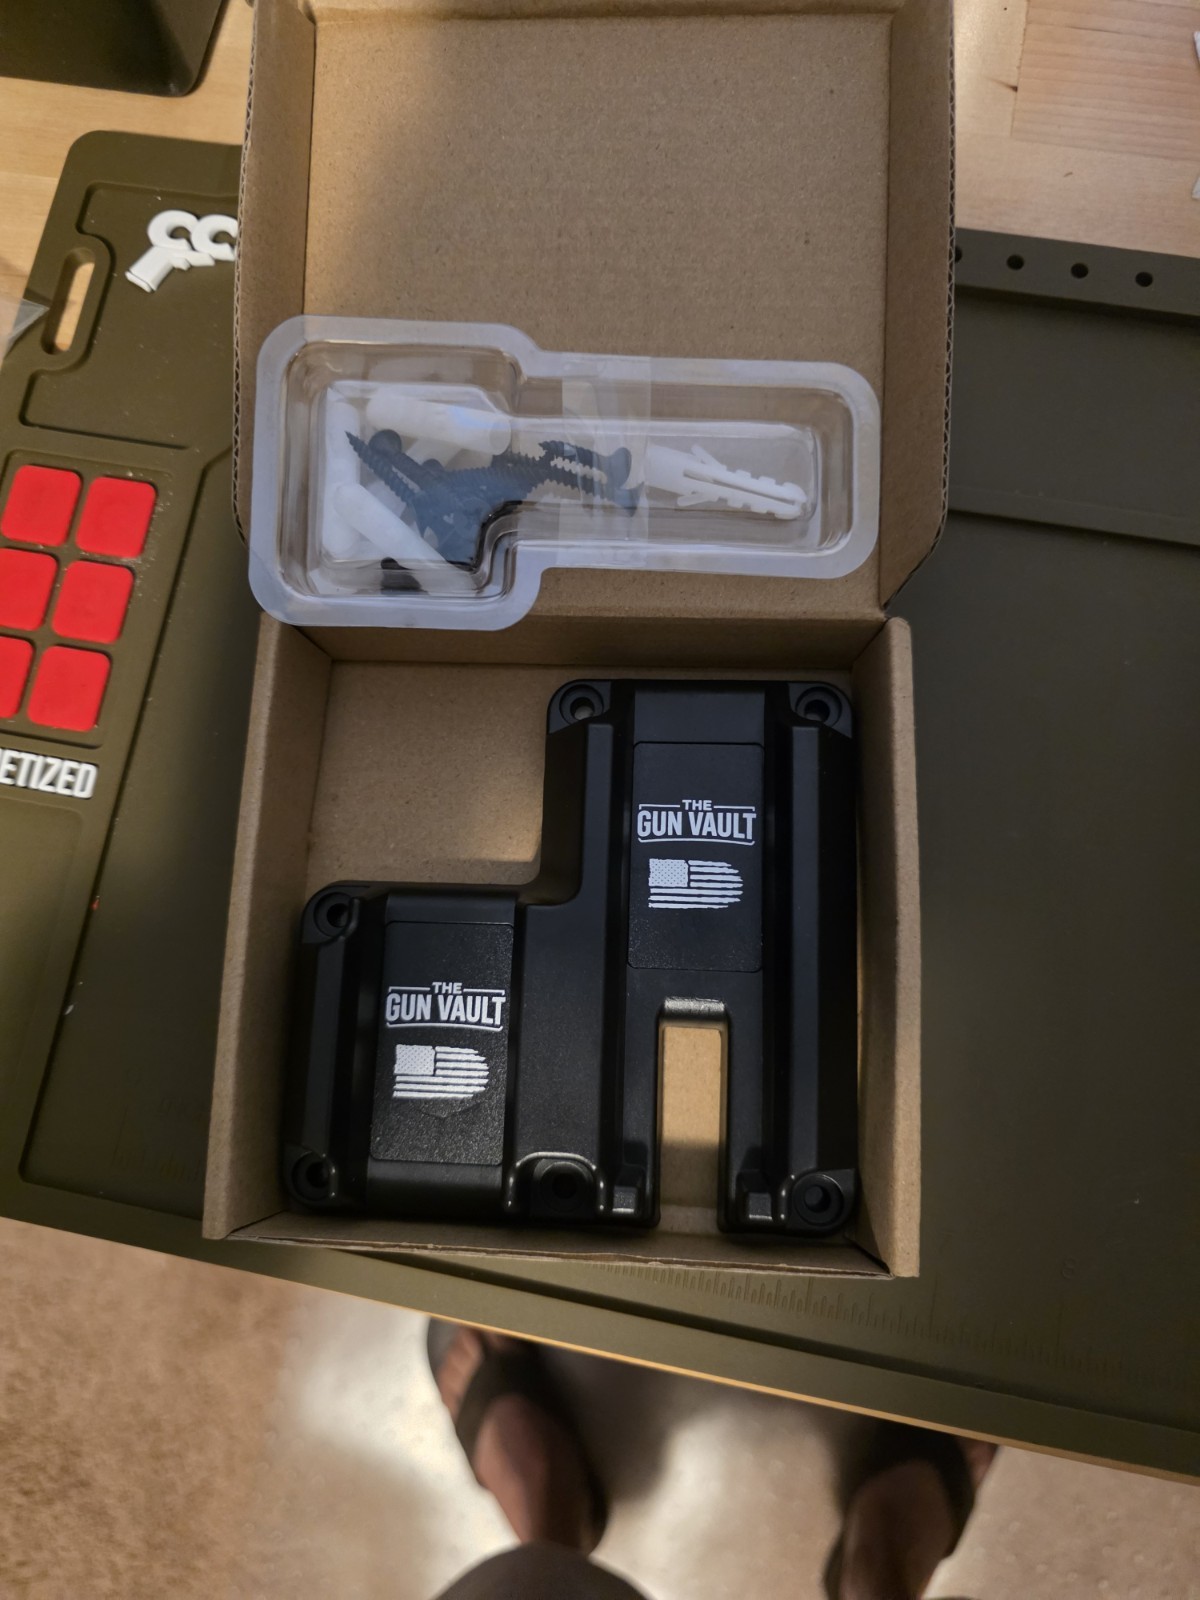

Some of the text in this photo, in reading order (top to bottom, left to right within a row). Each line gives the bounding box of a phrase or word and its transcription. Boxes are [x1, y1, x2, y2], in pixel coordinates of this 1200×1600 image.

[0, 747, 98, 799] ETIZED
[681, 799, 713, 811] THE
[637, 810, 757, 840] GUN VAULT
[431, 981, 463, 995] THE
[385, 992, 507, 1026] GUN VAULT
